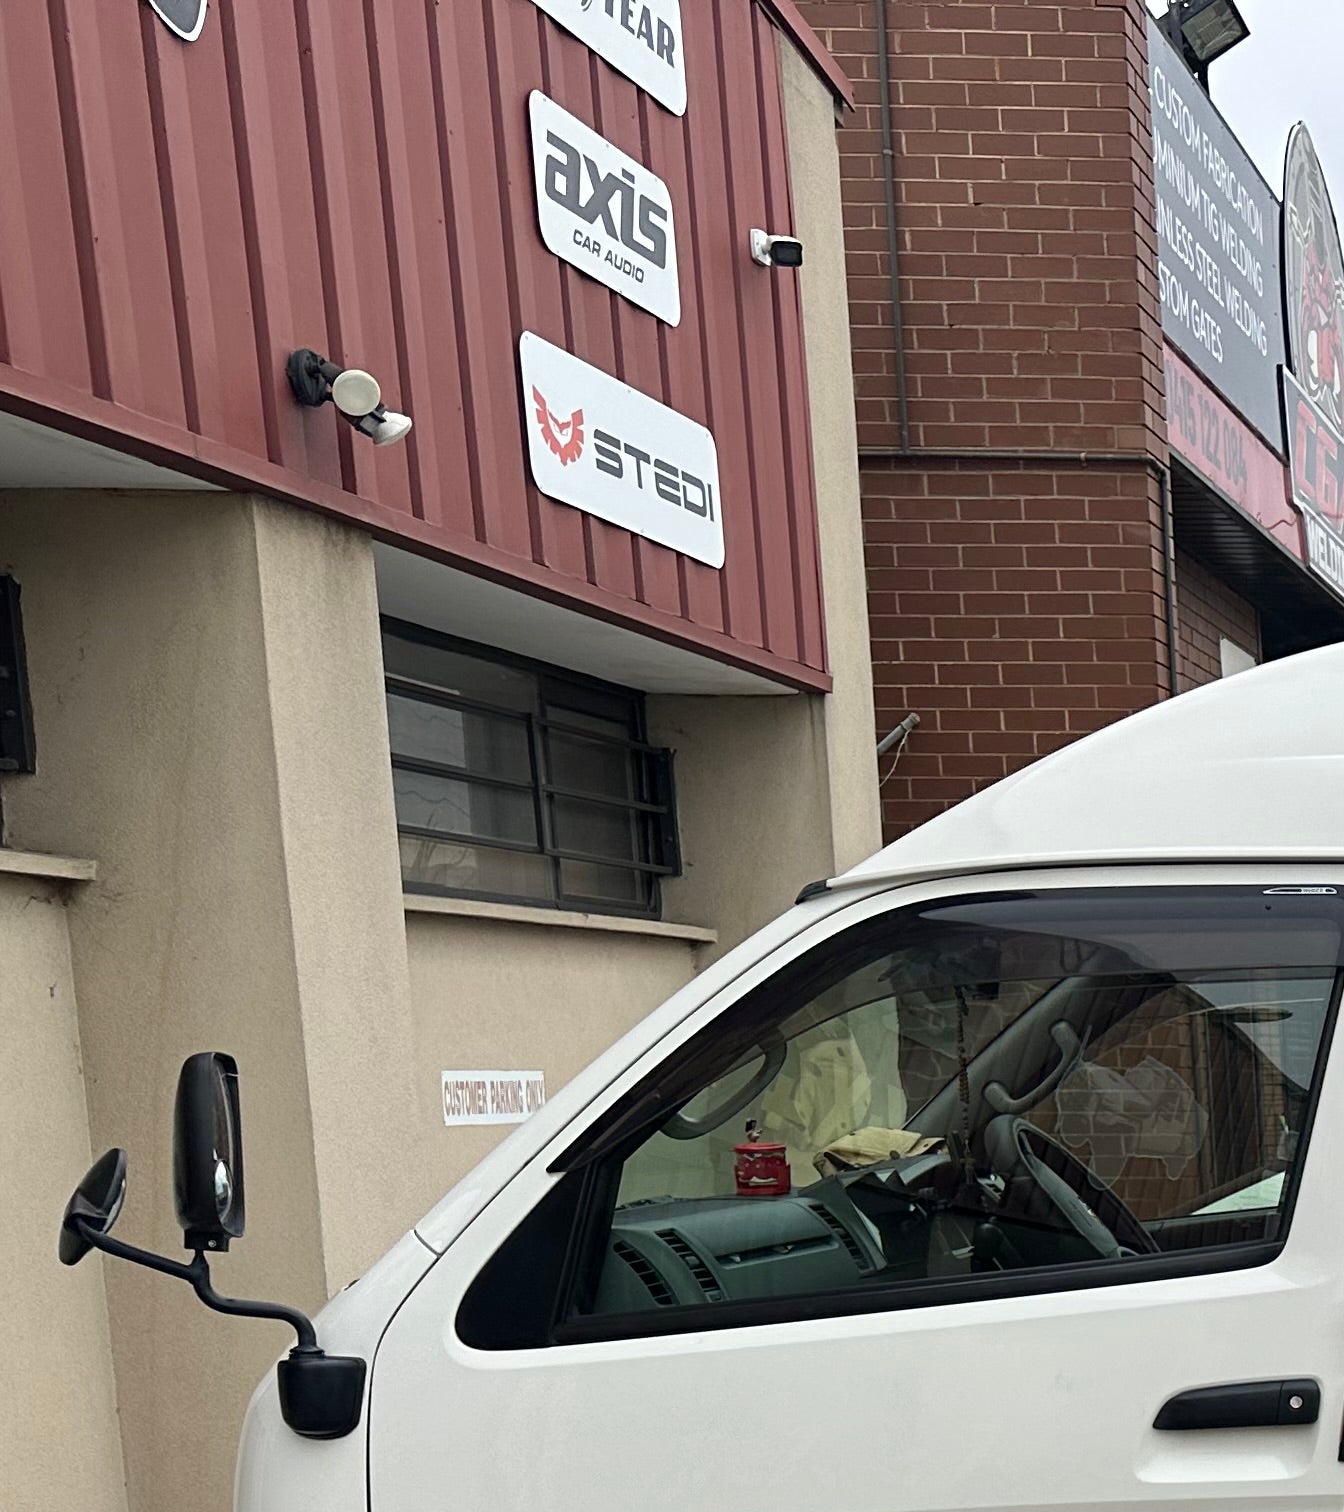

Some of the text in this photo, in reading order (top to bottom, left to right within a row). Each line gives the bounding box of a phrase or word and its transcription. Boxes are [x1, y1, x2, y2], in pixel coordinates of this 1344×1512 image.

[545, 128, 667, 270] axis
[1154, 66, 1263, 246] CUSTOM FABRICATION
[573, 229, 644, 283] CAR AUDIO
[1201, 189, 1219, 243] TIG
[1218, 212, 1263, 297] WELDING
[1191, 298, 1223, 363] GATES
[1195, 242, 1225, 308] STEEL
[1223, 275, 1268, 356] WELDING
[594, 428, 714, 522] STEDI
[1198, 393, 1222, 471] 122
[1223, 417, 1247, 495] 084
[444, 1080, 544, 1116] CUSTOMER PARKING ONLY
